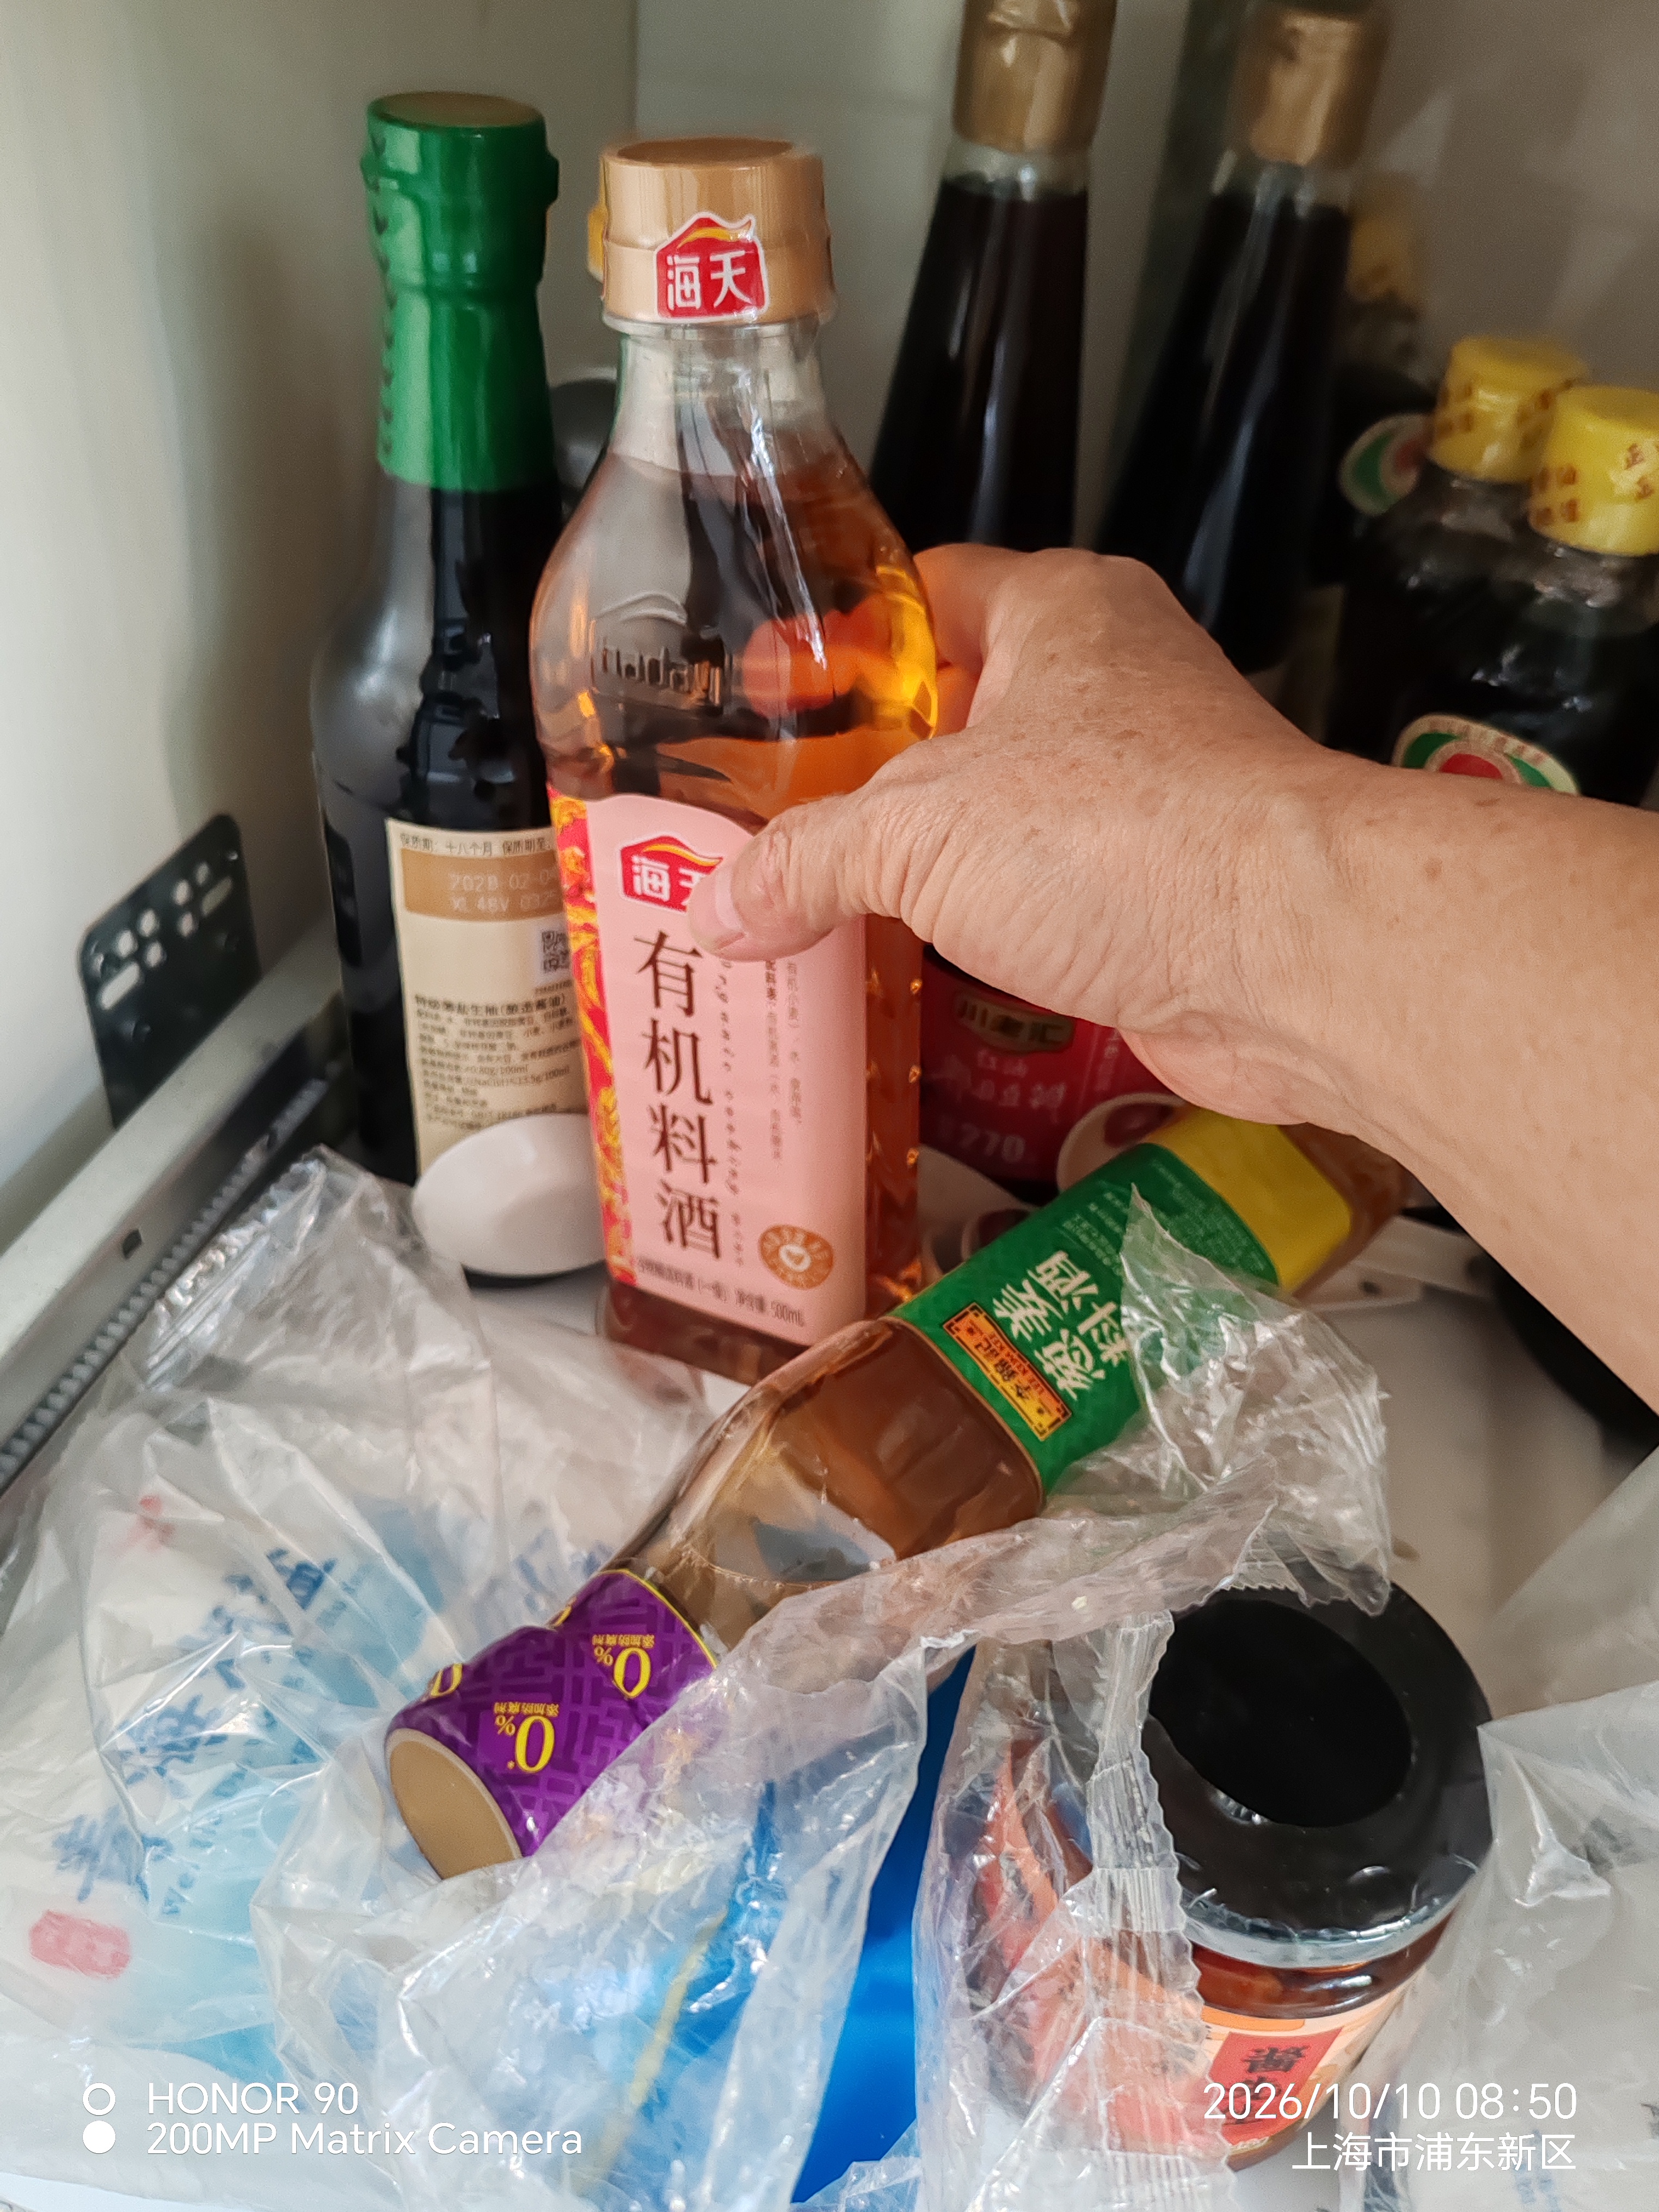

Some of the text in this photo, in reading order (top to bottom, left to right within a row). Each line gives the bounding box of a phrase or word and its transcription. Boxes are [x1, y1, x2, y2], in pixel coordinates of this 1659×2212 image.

[666, 250, 756, 310] 海天
[633, 930, 721, 1259] 有机料酒
